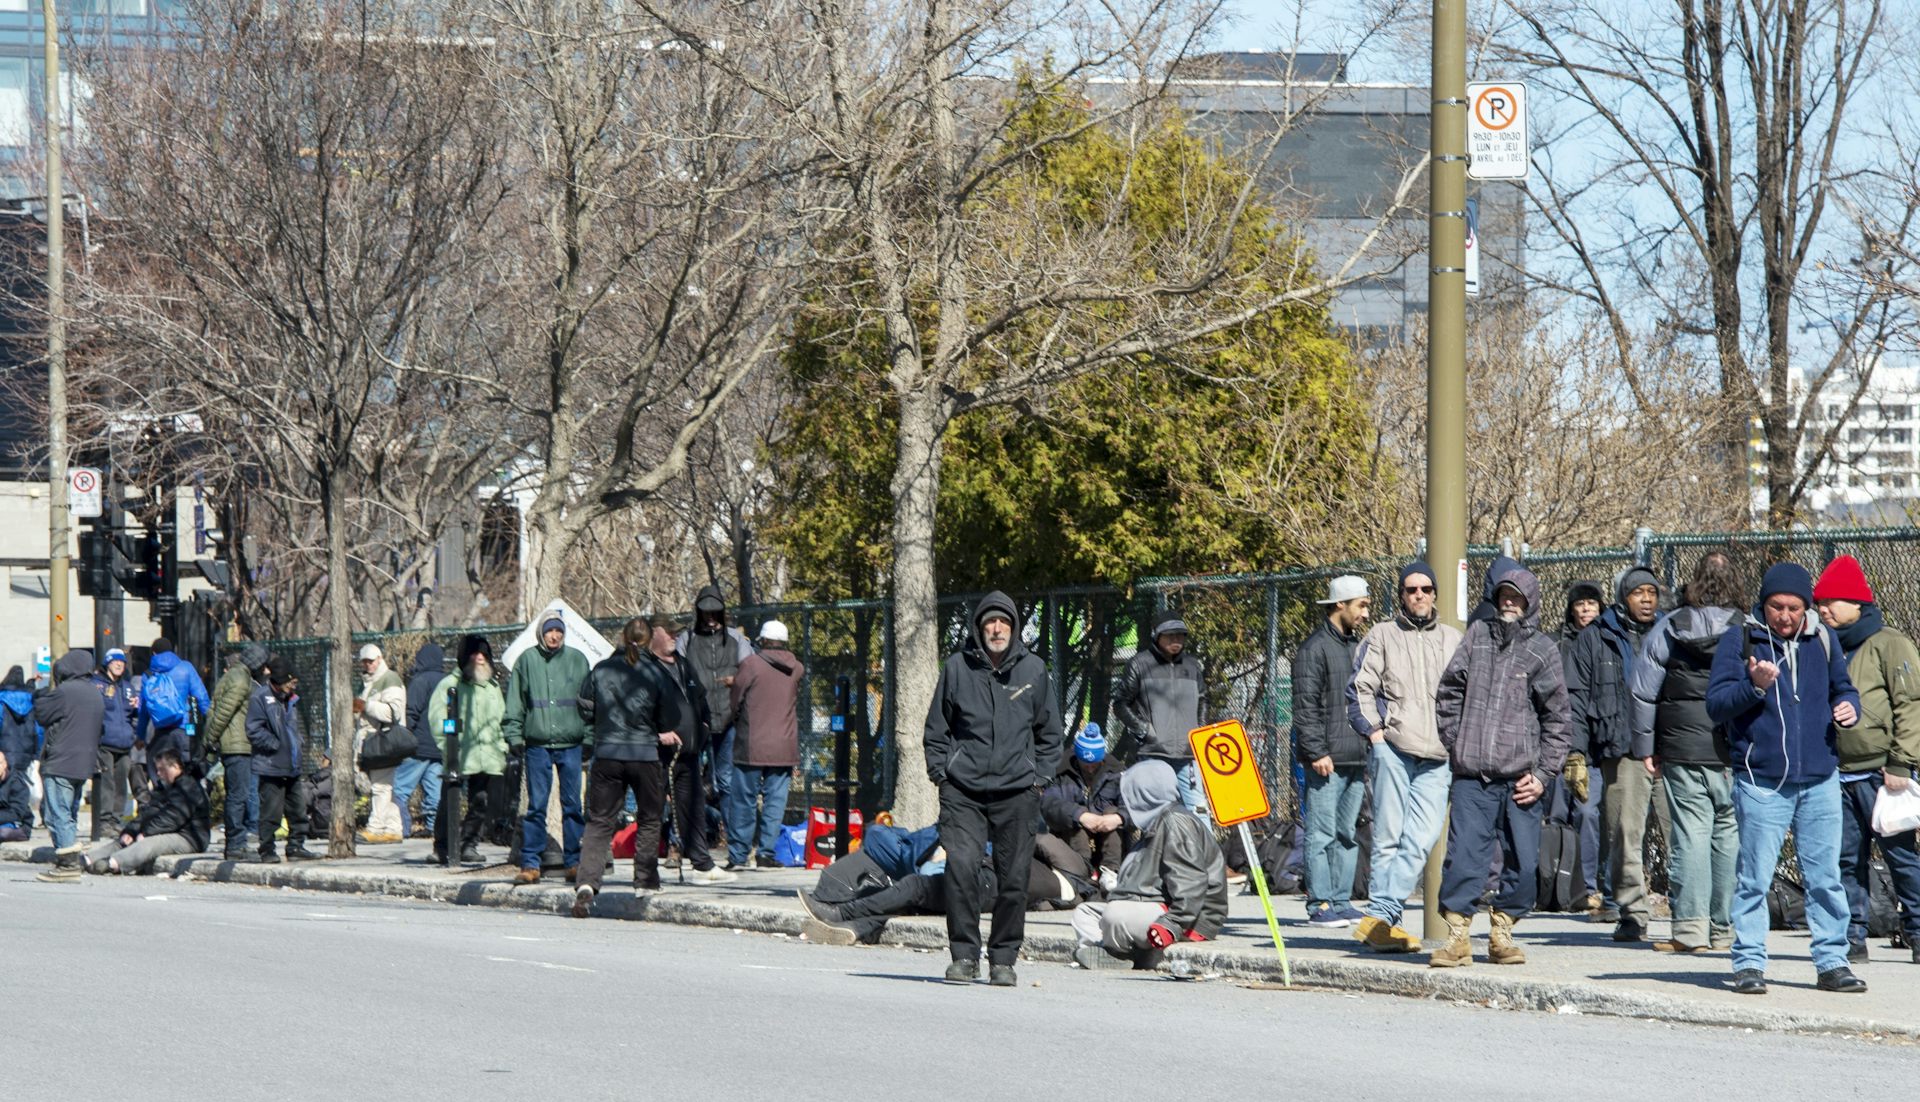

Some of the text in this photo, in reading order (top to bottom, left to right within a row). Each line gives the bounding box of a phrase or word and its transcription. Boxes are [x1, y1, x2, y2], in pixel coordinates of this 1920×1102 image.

[1499, 132, 1521, 141] 10h30
[1476, 143, 1491, 152] LUN
[1504, 142, 1518, 151] JEU
[1477, 154, 1494, 162] AVRIL
